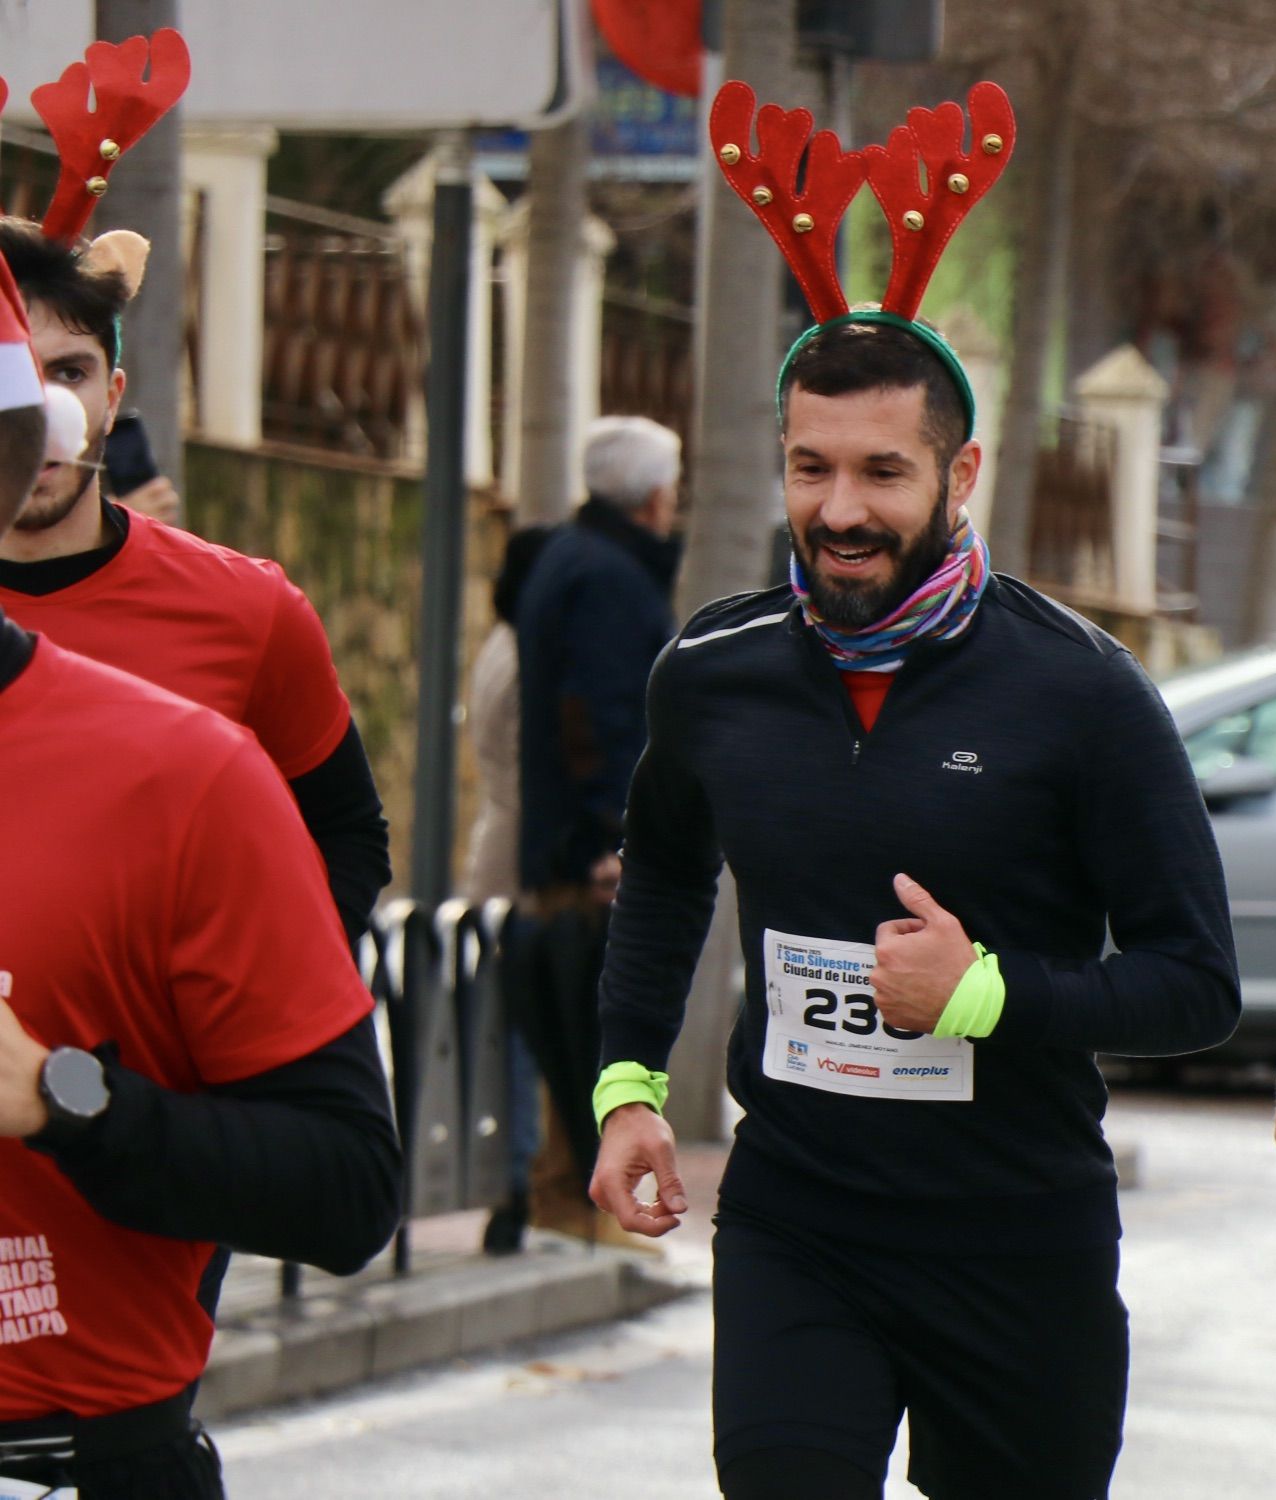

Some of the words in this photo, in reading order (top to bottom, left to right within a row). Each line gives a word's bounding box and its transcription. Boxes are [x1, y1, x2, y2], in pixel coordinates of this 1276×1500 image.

[942, 762, 983, 774] Kalenji
[785, 950, 804, 965] San
[807, 955, 860, 972] Silvestre
[784, 963, 822, 979] Ciudad
[825, 970, 840, 982] de
[893, 1066, 949, 1077] enerplus
[0, 1310, 68, 1346] ALIZO
